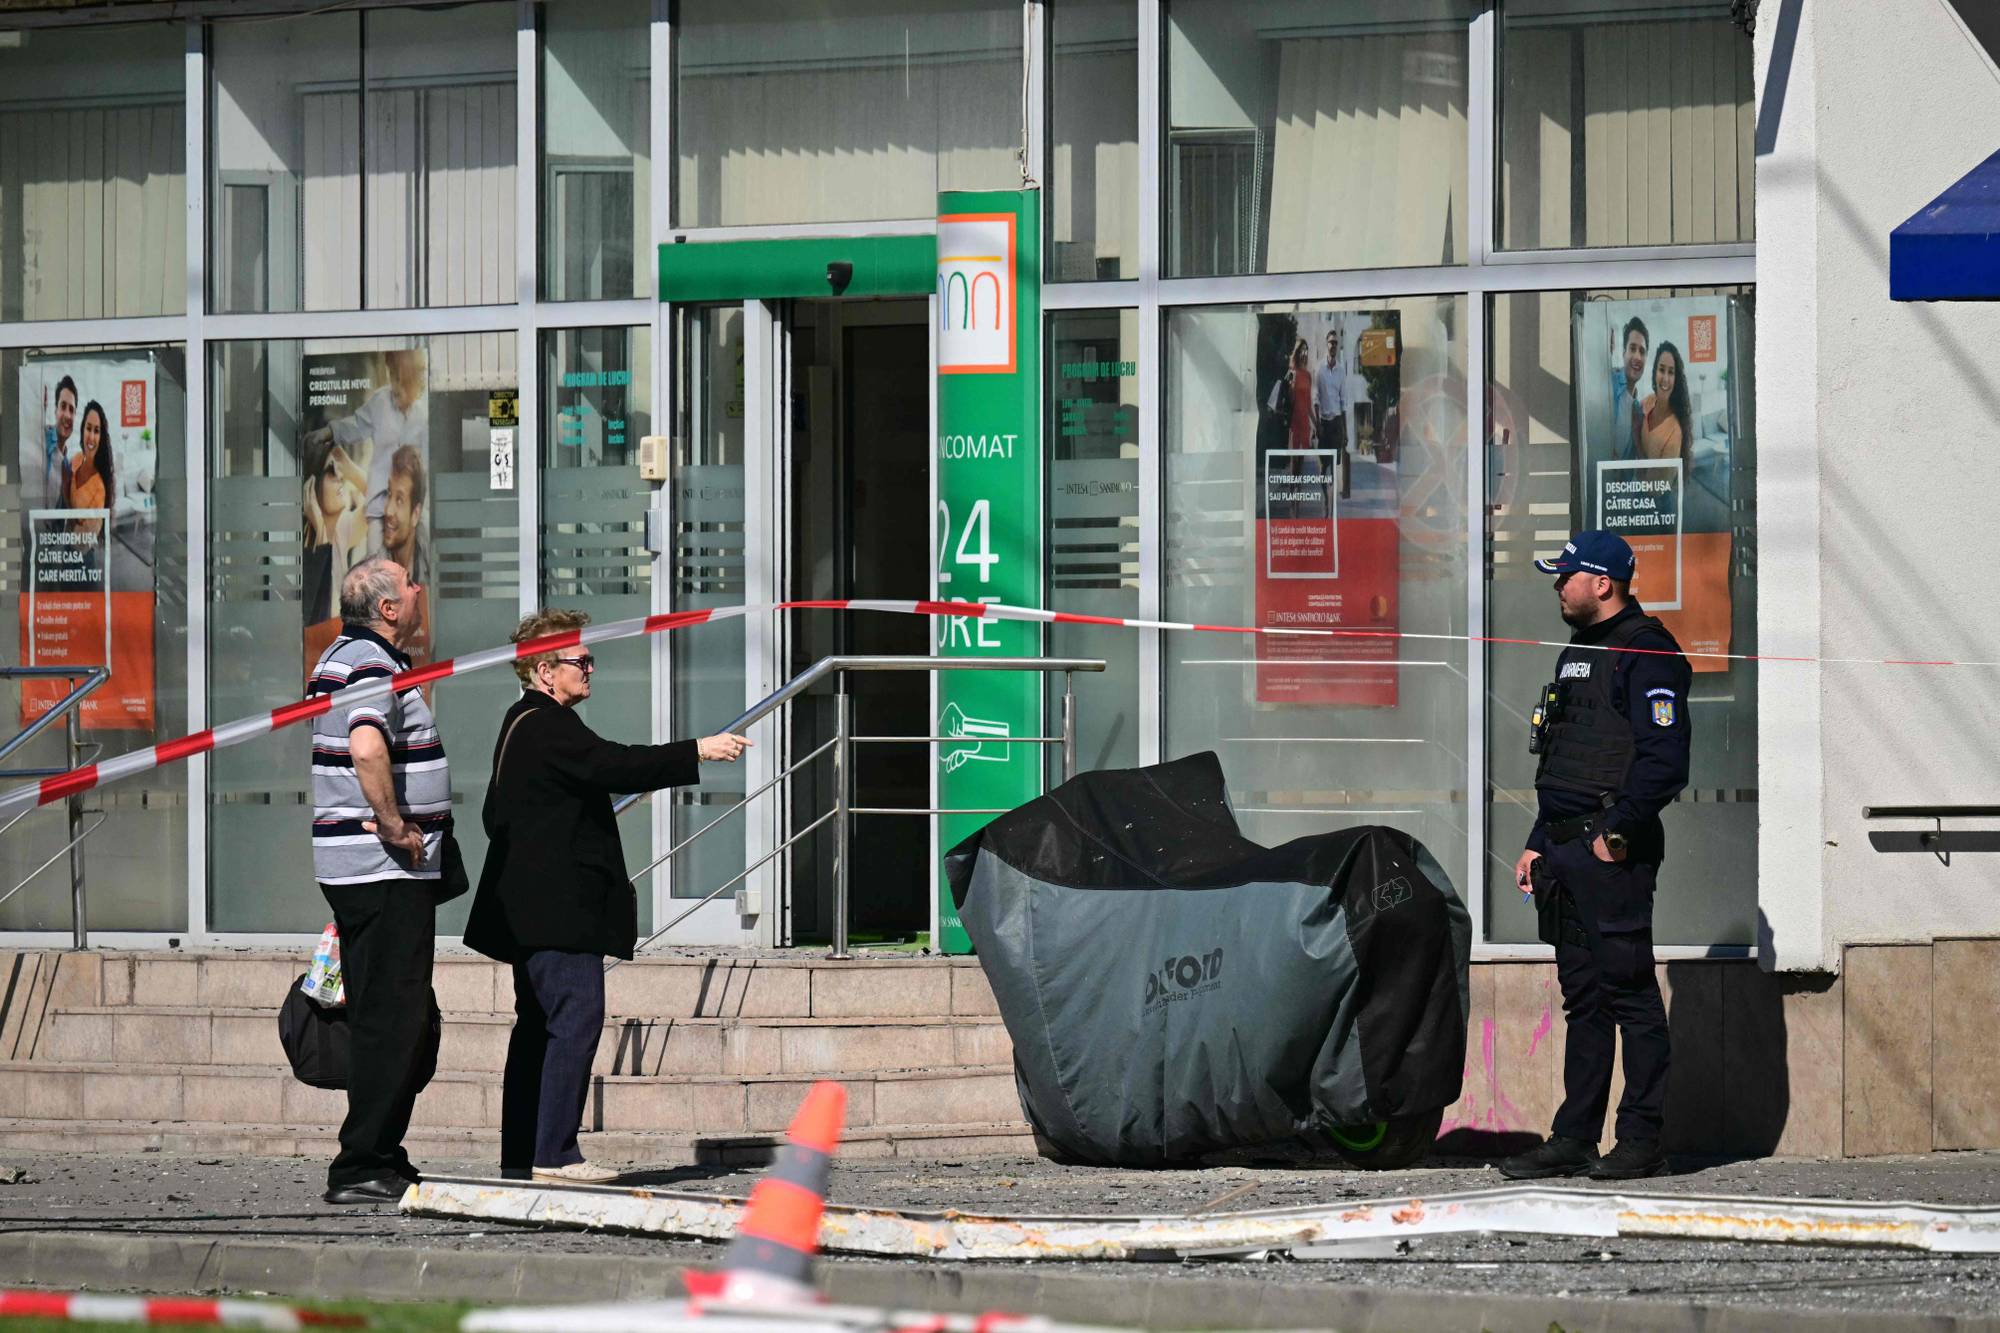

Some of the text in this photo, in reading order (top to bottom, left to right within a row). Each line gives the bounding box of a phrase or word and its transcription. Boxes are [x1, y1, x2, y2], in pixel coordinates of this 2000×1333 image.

[1100, 361, 1110, 378] DE
[1111, 361, 1136, 377] LUCRU
[309, 380, 341, 392] CREDITUL
[342, 379, 350, 390] DE
[597, 371, 607, 386] DE
[309, 394, 347, 406] PERSONALE
[1268, 475, 1333, 484] CITYBREAK SPONTAN
[1606, 480, 1672, 495] DESCHIDEM UȘA
[1269, 492, 1321, 501] SAU PLANIFICAT?
[1605, 495, 1656, 510] CĂTRE CASA
[1605, 511, 1676, 527] CARE MERITĂ TOT
[39, 532, 81, 545] DESCHIDEM
[38, 548, 84, 563] CĂTRE CASA
[38, 566, 102, 582] CARE MERITĂ TOT
